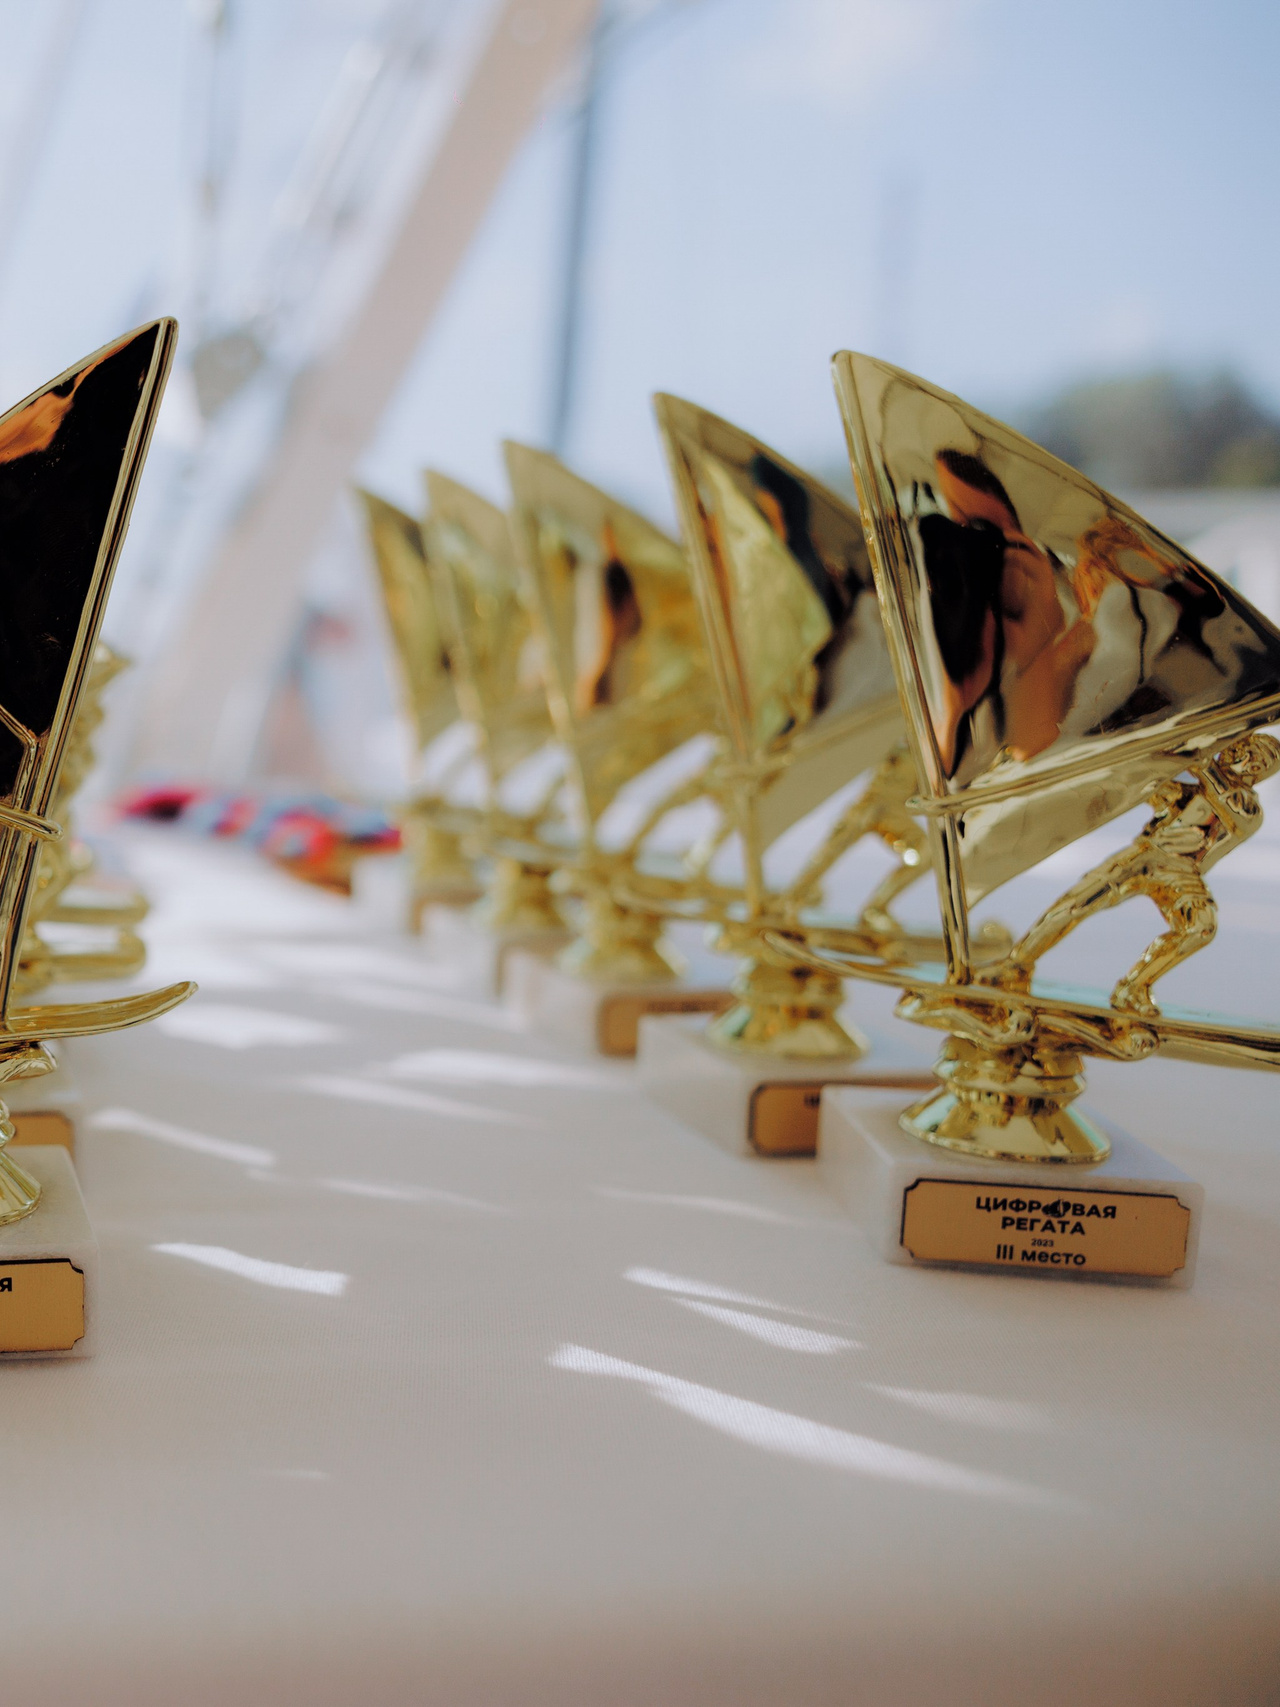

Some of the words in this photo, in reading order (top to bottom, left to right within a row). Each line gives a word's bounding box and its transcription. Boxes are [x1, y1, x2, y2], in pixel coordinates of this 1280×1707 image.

[1001, 1216, 1086, 1235] РЕГАТА
[1031, 1238, 1054, 1248] 2023
[996, 1244, 1014, 1260] III
[1021, 1249, 1086, 1266] место
